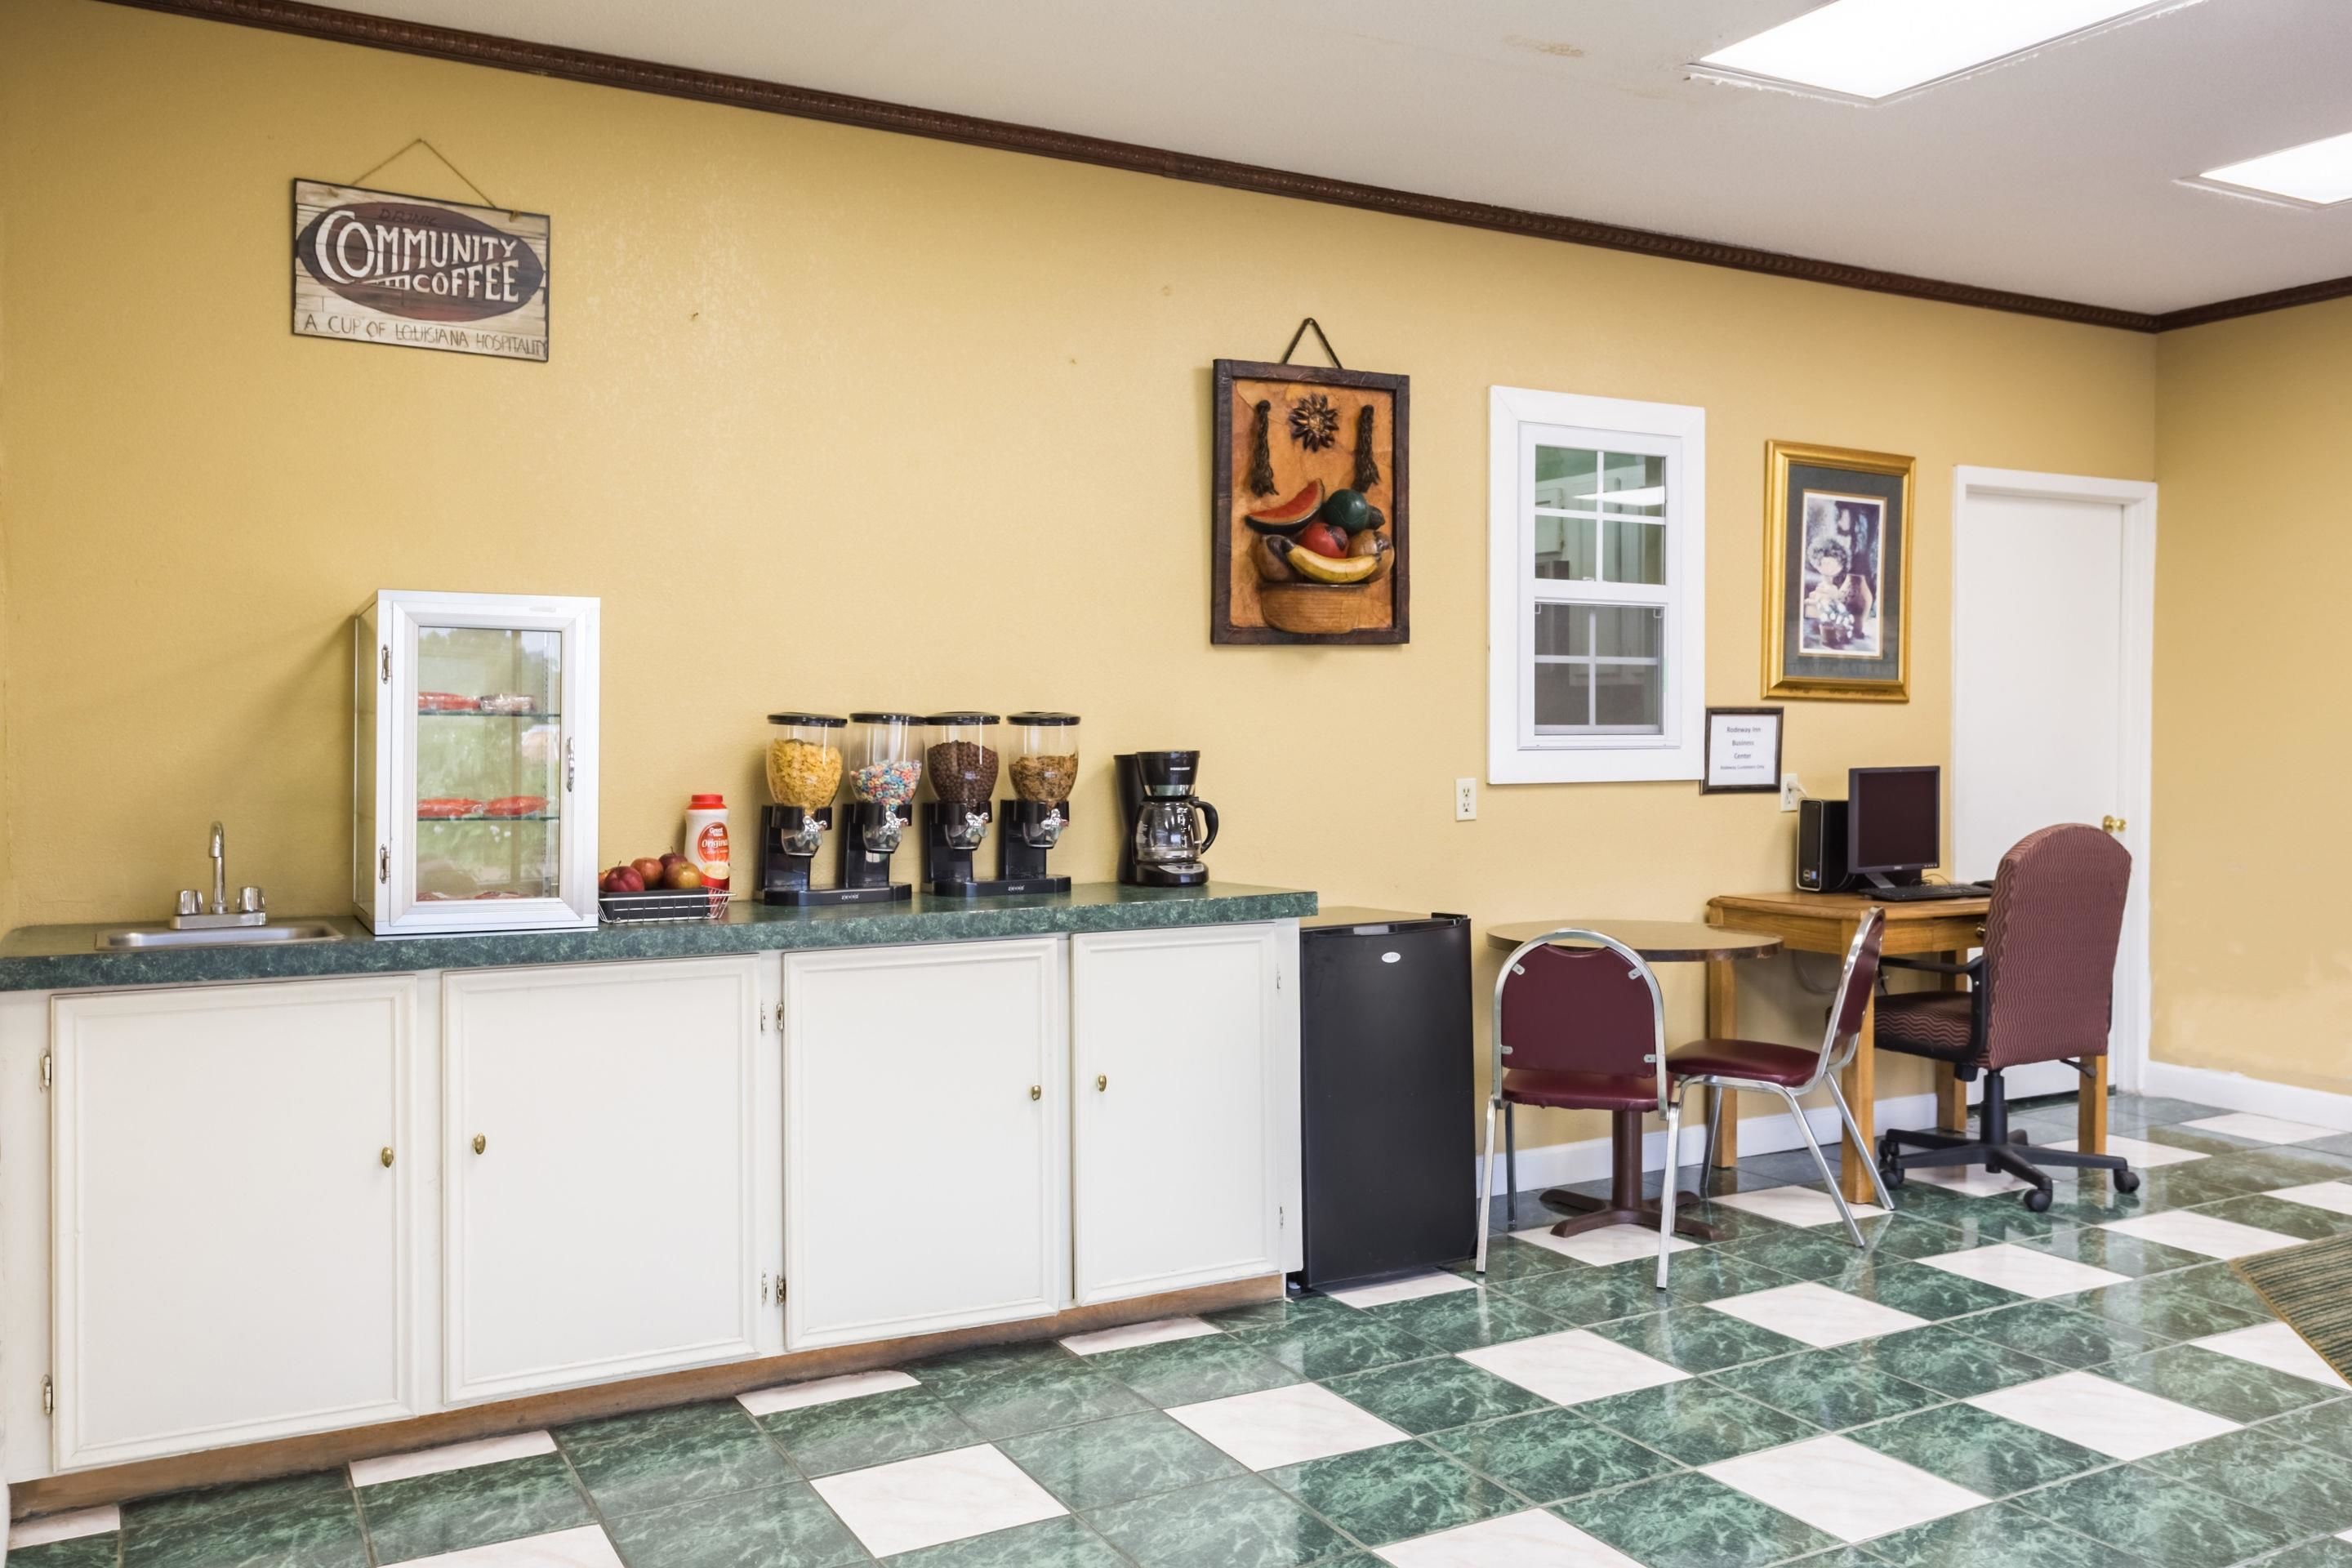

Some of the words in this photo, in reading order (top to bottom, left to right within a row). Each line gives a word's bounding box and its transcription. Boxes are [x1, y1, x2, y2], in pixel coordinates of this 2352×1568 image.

[377, 207, 438, 226] DRINK
[315, 210, 518, 284] COMMUNITY
[412, 259, 519, 303] COFFEE
[304, 314, 318, 332] A
[327, 314, 360, 334] CUP
[367, 321, 386, 341] OF
[395, 323, 469, 348] LOUISIANA
[476, 333, 547, 355] HOSPITALITY
[702, 838, 728, 849] Origina
